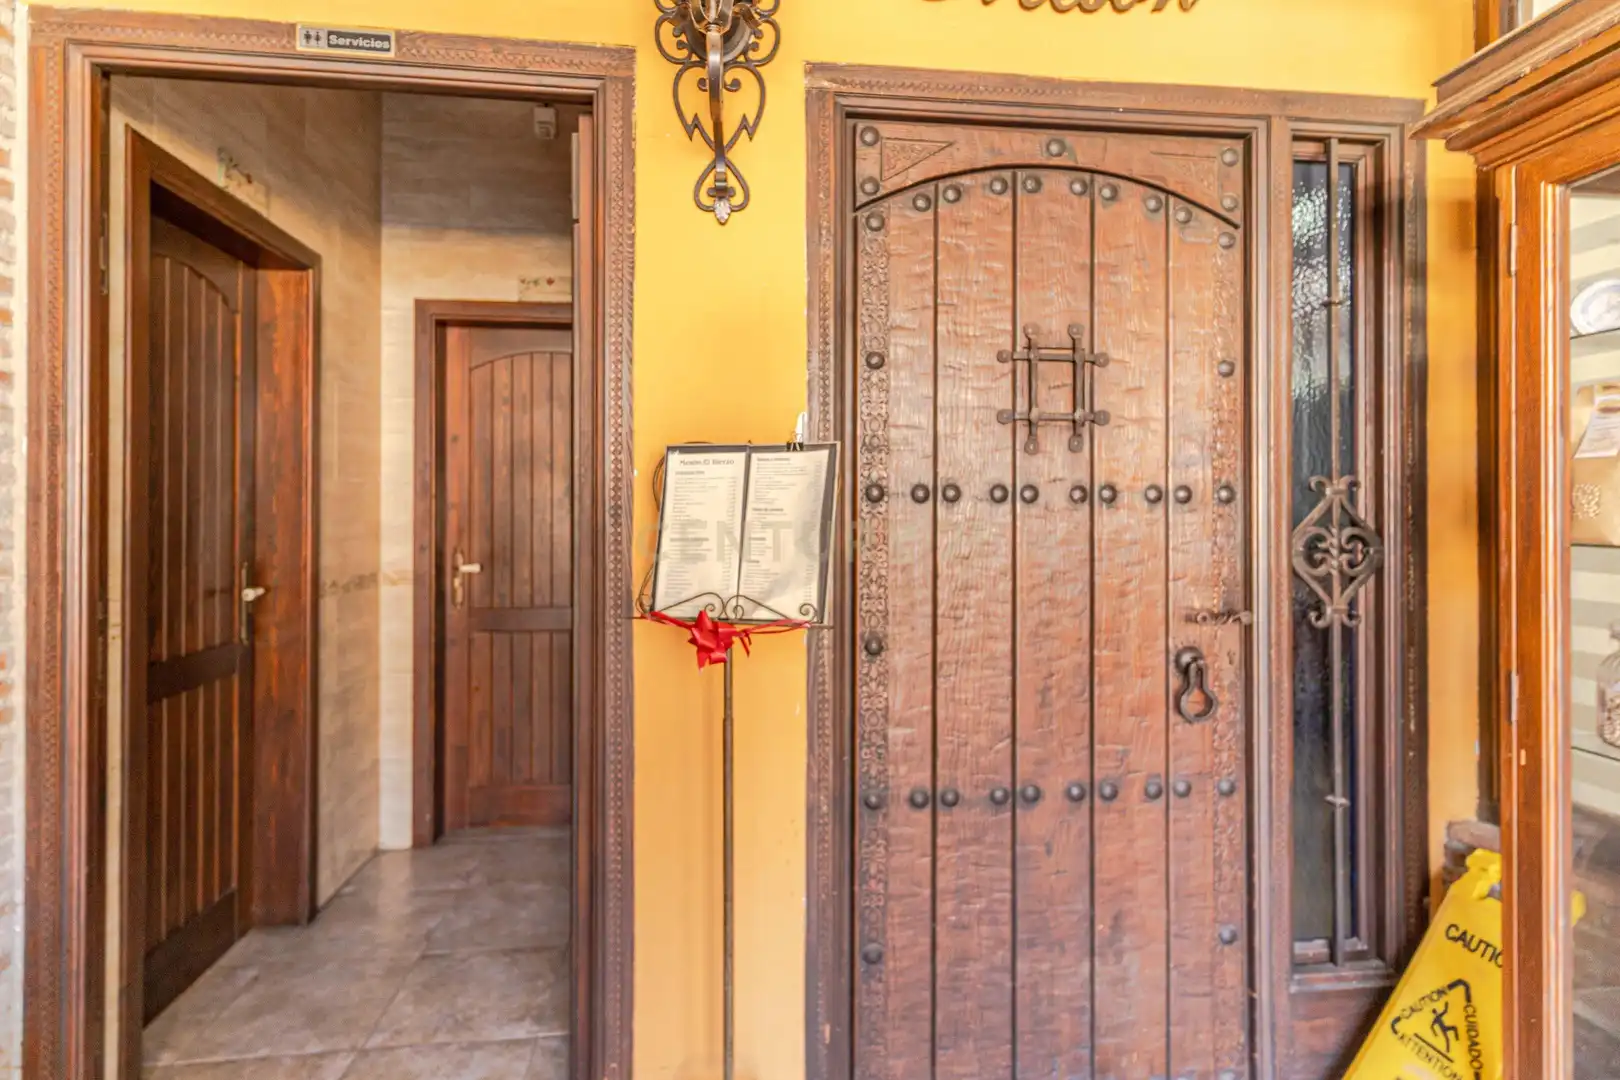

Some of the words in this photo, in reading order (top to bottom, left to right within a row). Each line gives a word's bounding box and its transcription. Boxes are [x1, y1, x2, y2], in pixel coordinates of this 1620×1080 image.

[329, 35, 390, 49] Servicios
[1401, 987, 1447, 1019] CAUTION
[1464, 1004, 1484, 1070] CUIDADO
